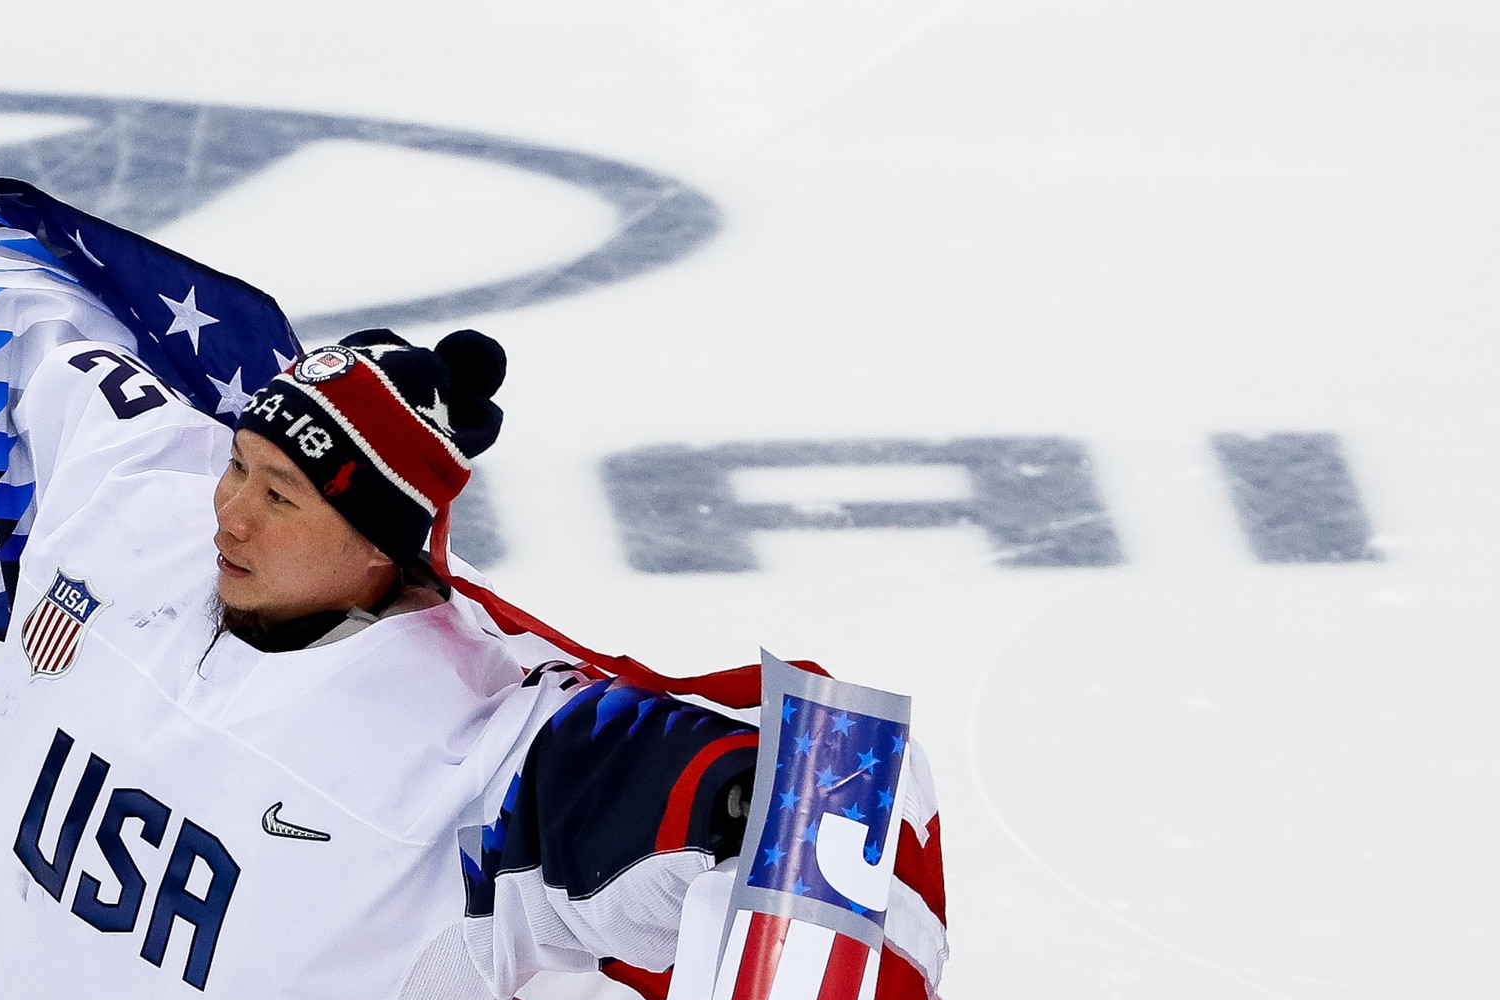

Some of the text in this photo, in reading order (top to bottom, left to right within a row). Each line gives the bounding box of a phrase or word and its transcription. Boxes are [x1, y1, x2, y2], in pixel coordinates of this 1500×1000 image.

[68, 349, 170, 420] 2
[55, 580, 90, 618] USA
[12, 726, 243, 993] USA
